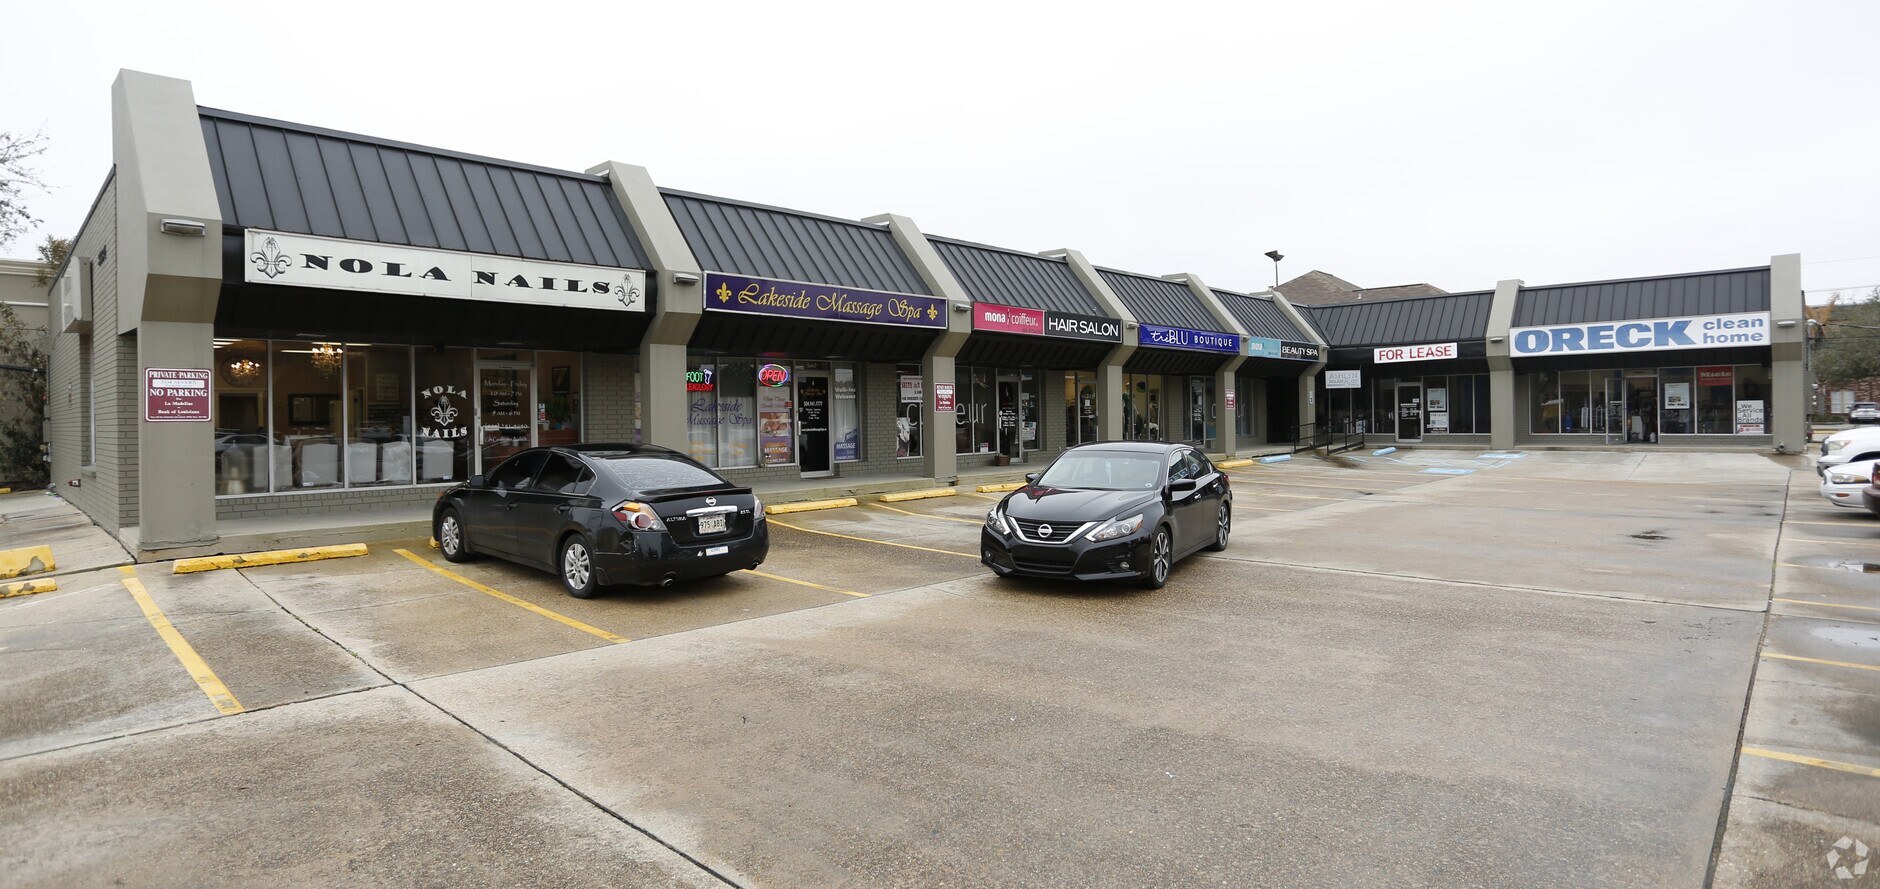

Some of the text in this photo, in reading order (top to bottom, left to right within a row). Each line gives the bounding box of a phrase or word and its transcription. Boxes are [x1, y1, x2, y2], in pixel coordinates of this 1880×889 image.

[300, 254, 610, 294] NOLA NAILS
[738, 283, 922, 322] Lakeside Massage Spa
[985, 312, 1036, 326] mona coiffeur
[1703, 318, 1764, 330] clean
[1048, 317, 1119, 336] HAIR SALON
[1194, 335, 1232, 347] BOUTIQUE
[1514, 320, 1696, 353] ORECK
[1703, 331, 1764, 345] home
[1282, 346, 1319, 356] BEAUTY SPA
[1379, 346, 1452, 361] FOR LEASE
[179, 371, 208, 379] PARKING
[686, 371, 704, 382] FOOT
[761, 370, 786, 382] OPEN
[150, 389, 208, 397] NO PARKING
[421, 385, 467, 399] NOLA
[690, 397, 742, 413] Lakeside
[687, 413, 753, 427] Massage Spa
[421, 426, 468, 438] NAILS
[700, 521, 710, 529] 975
